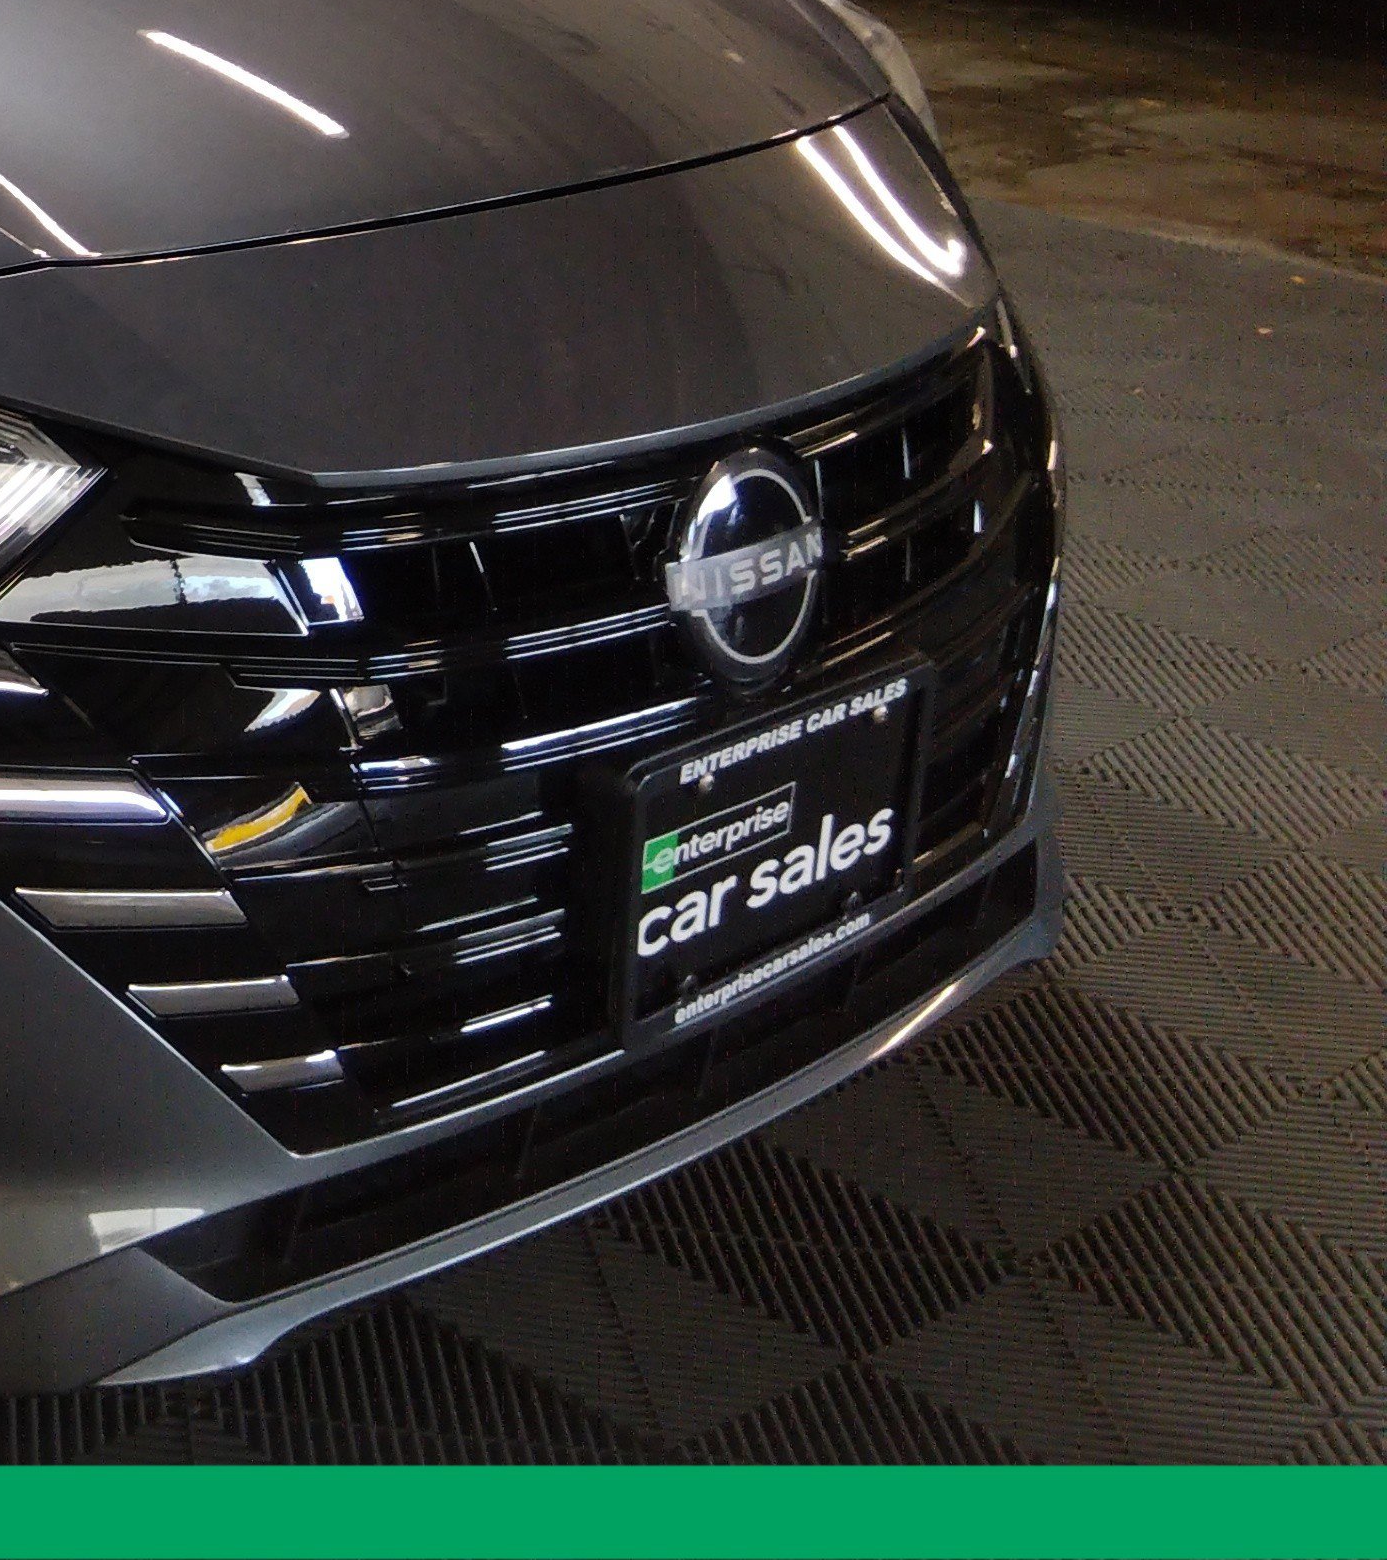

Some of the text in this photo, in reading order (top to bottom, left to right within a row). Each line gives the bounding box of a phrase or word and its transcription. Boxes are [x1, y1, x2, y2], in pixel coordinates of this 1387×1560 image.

[673, 527, 824, 604] NISSAN
[679, 678, 909, 786] ENTERPRISE CAR SALES
[636, 806, 896, 958] car sales
[648, 798, 790, 876] enterprise
[673, 912, 872, 1025] enterprisecarsales.com
